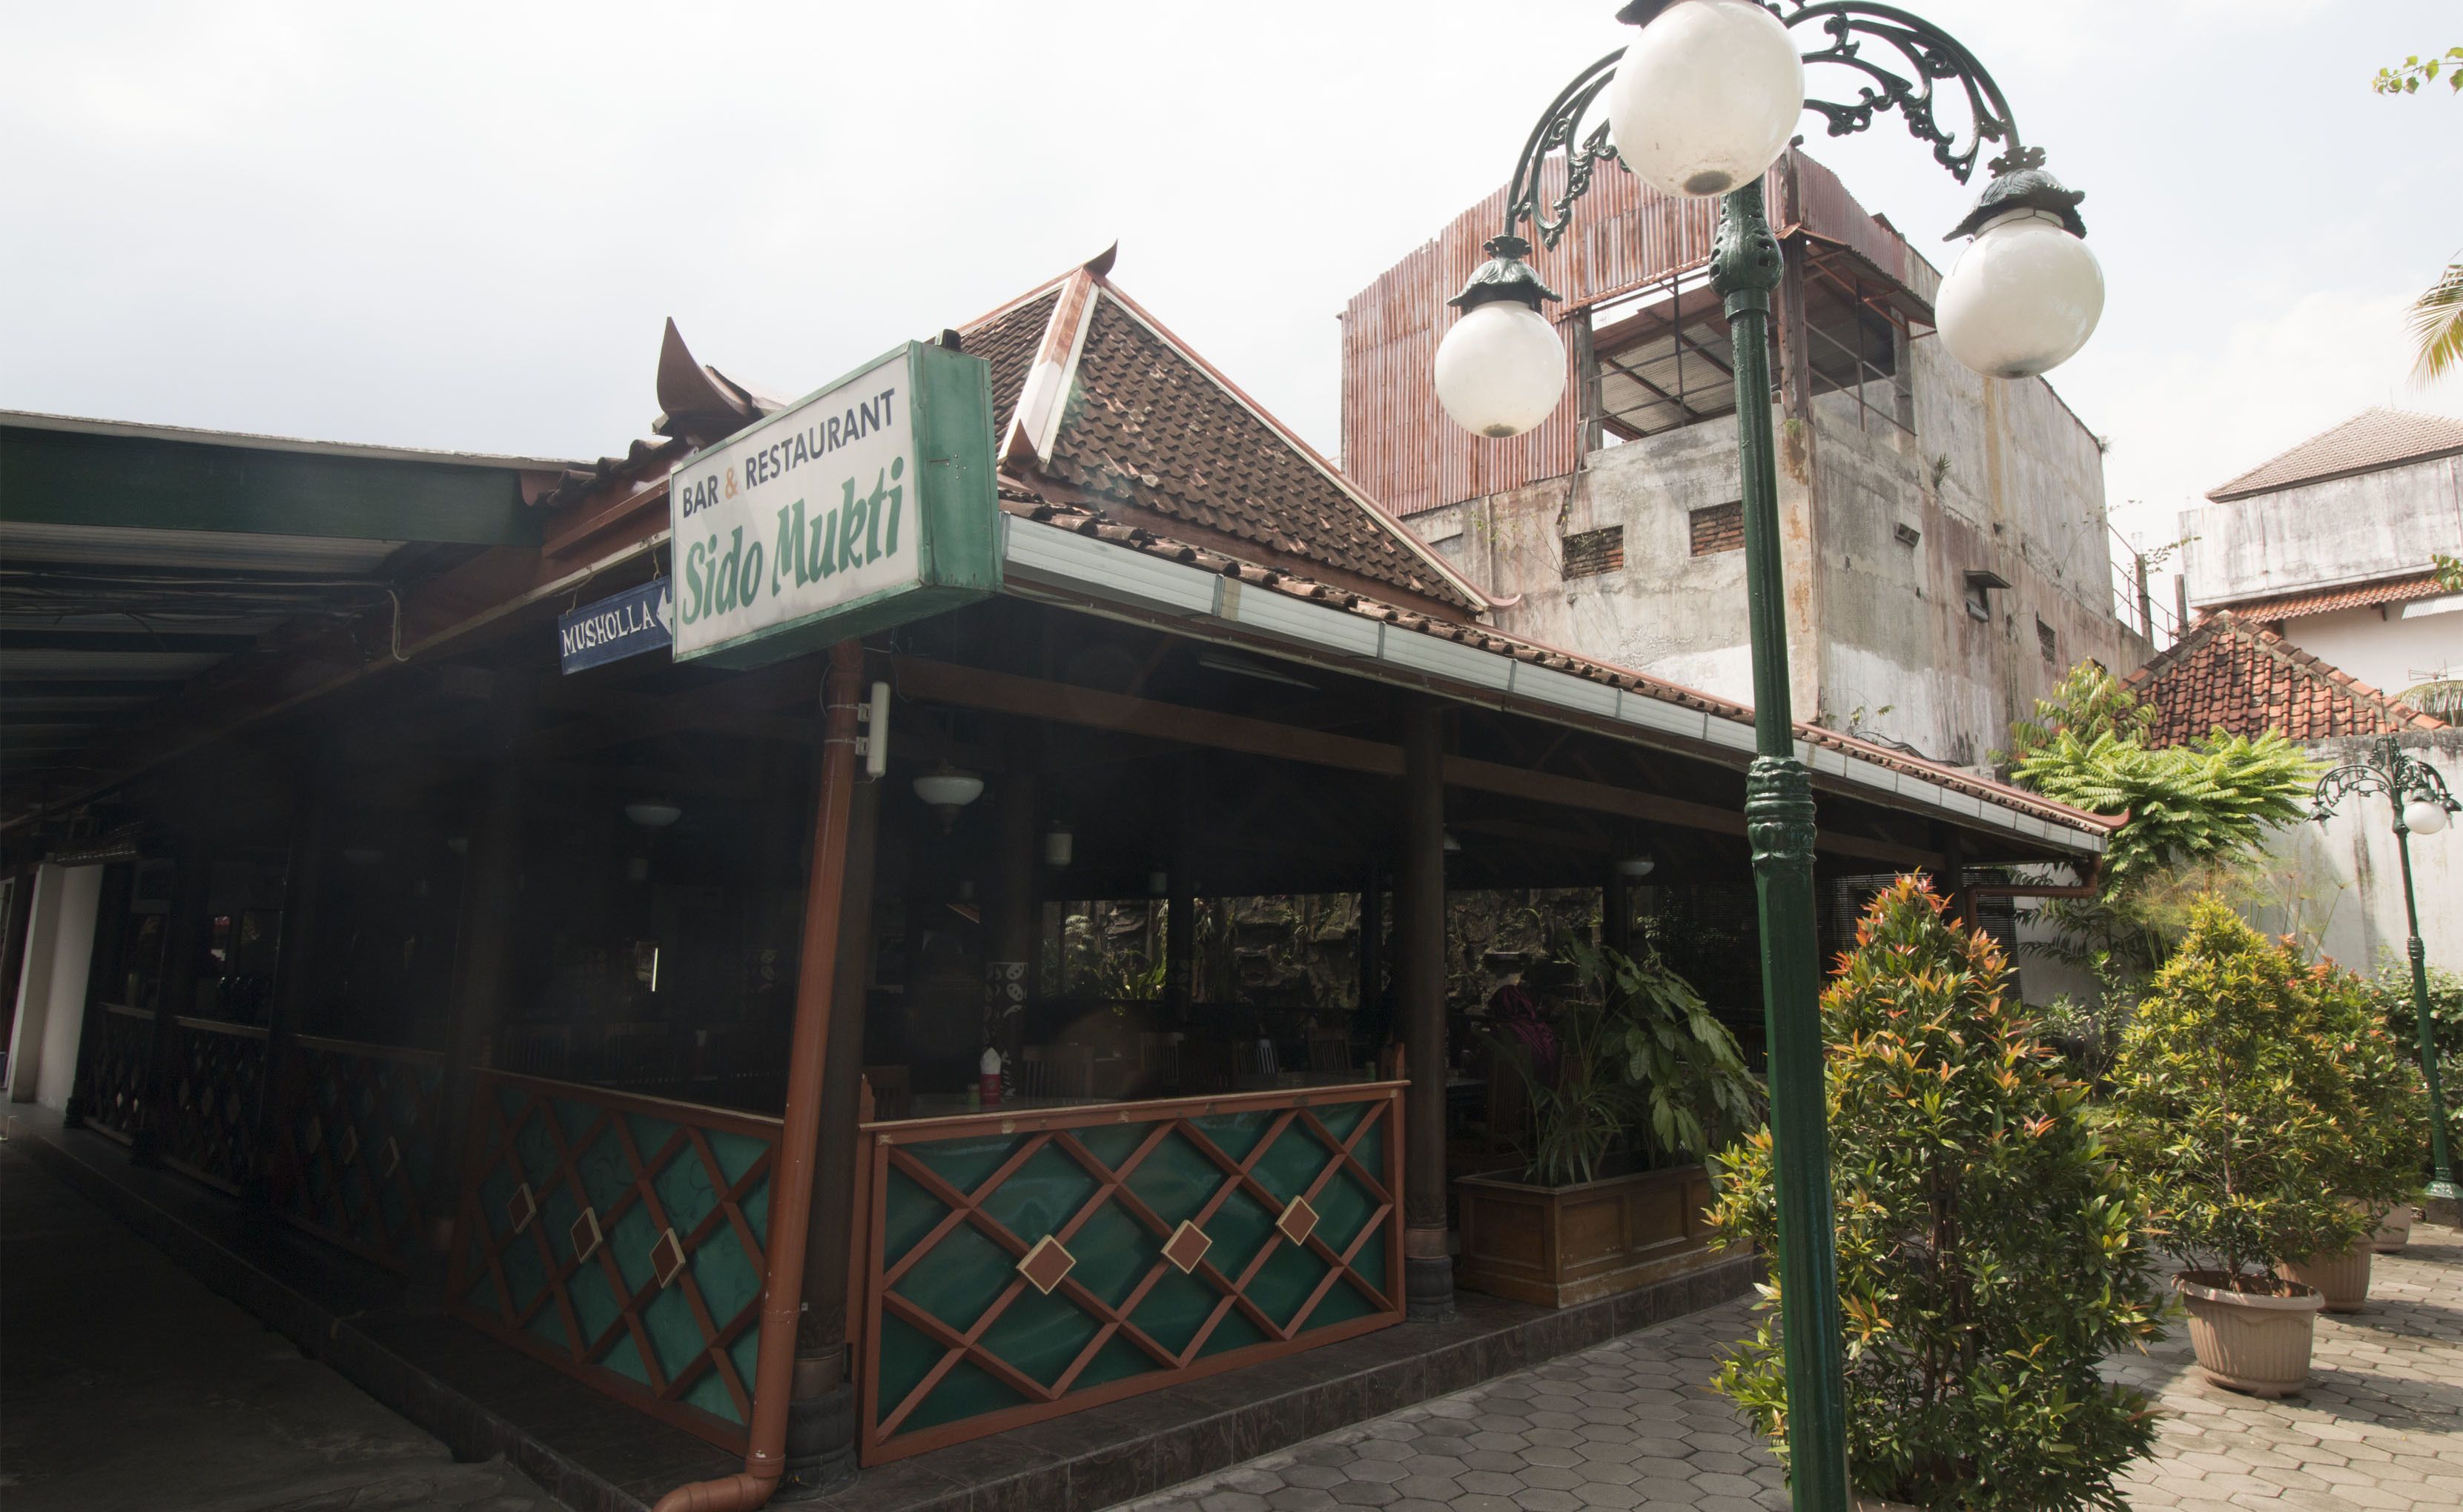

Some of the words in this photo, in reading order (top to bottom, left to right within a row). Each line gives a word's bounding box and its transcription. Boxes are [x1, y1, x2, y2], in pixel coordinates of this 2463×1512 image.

[682, 475, 719, 518] BAR
[725, 467, 738, 500] &
[745, 388, 896, 490] RESTAURANT
[682, 524, 764, 625] Sido
[772, 456, 905, 597] Mukti
[561, 600, 656, 657] MUSHOLLA
